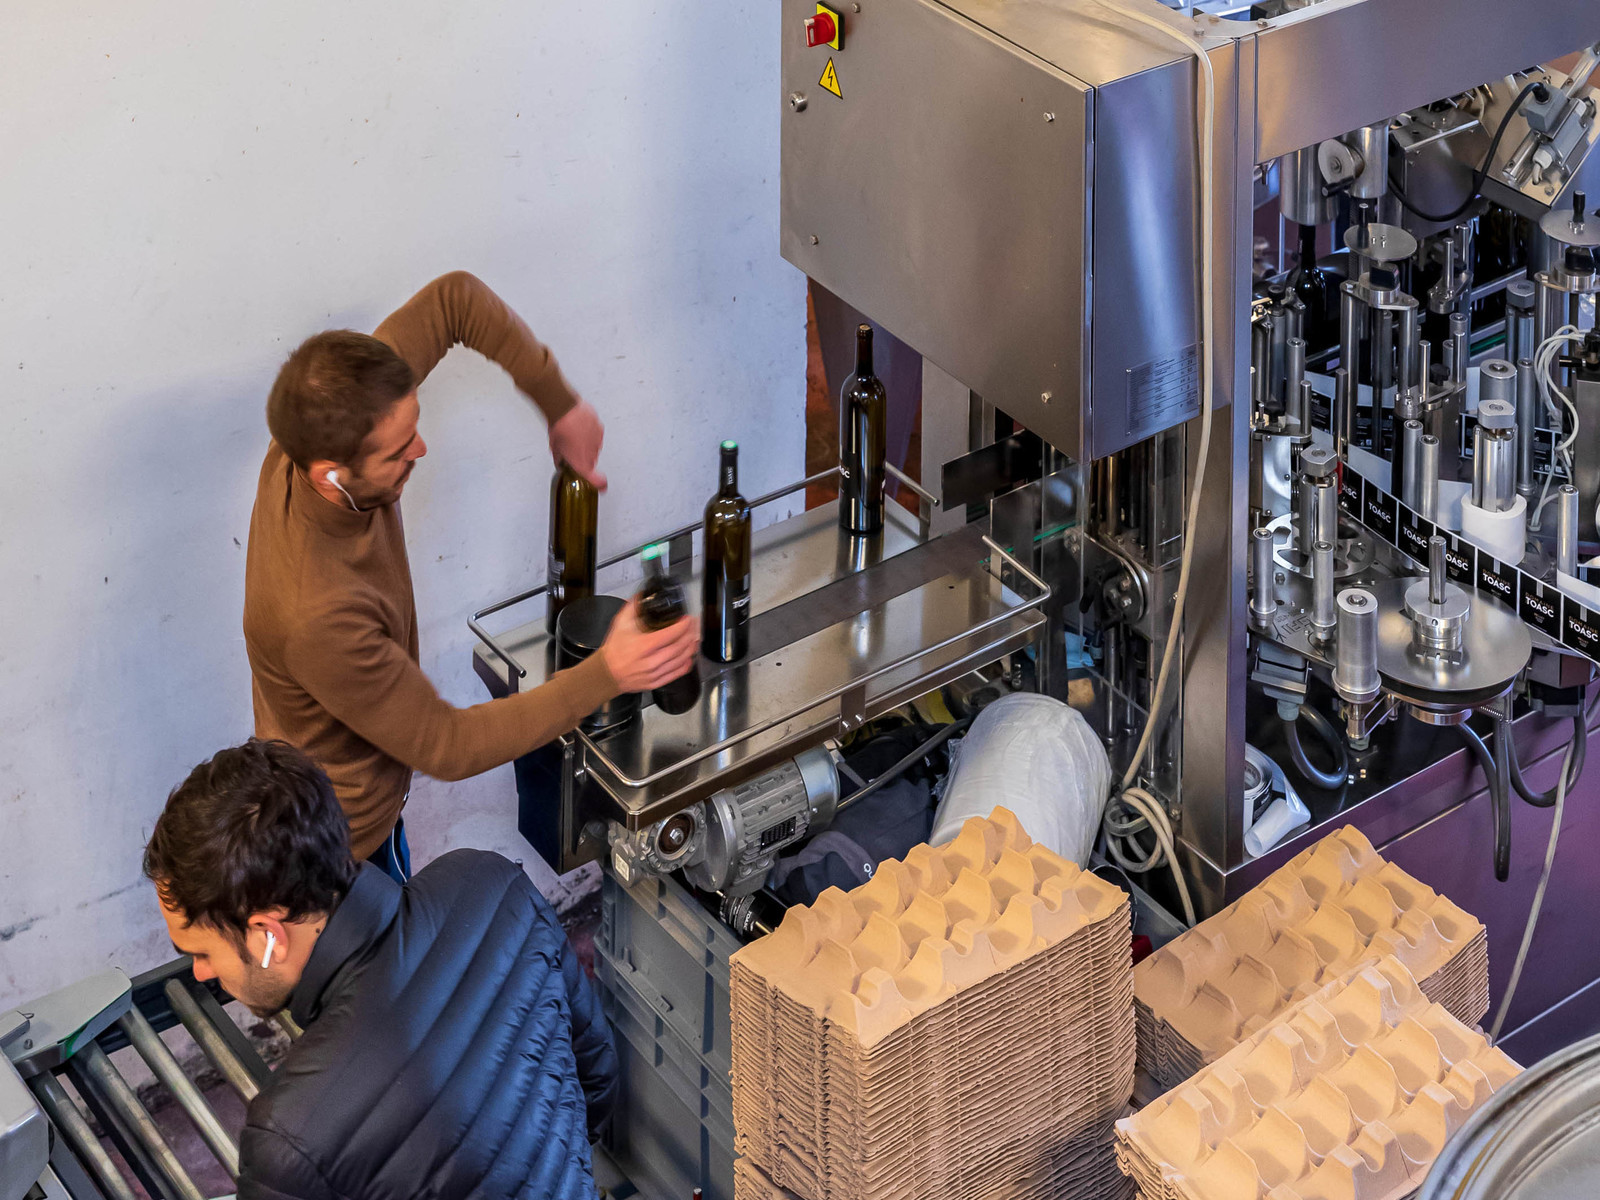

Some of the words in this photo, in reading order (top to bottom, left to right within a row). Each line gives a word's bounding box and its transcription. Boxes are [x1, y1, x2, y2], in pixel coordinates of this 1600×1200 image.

[1368, 501, 1391, 524] TOASC
[1403, 526, 1428, 549] TOASC
[1482, 573, 1511, 594] TOASC
[1525, 596, 1554, 618] TOASC
[1569, 620, 1599, 642] TOASC
